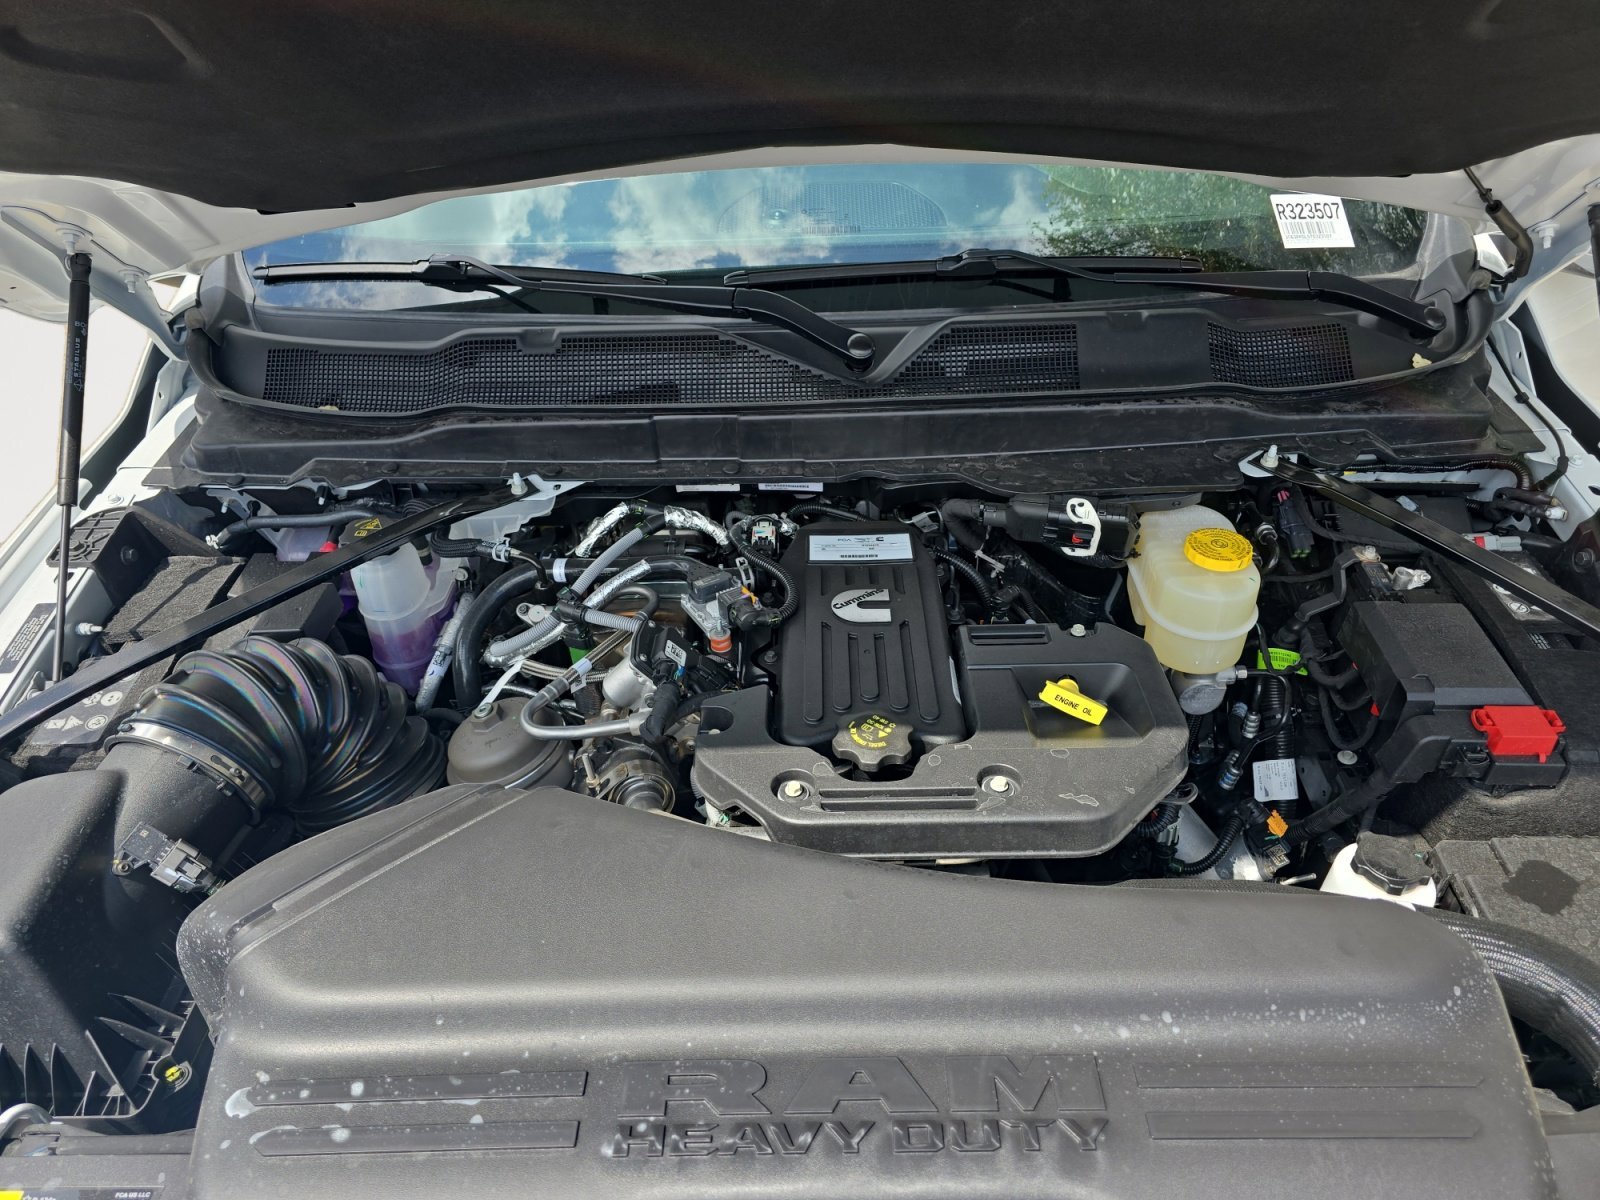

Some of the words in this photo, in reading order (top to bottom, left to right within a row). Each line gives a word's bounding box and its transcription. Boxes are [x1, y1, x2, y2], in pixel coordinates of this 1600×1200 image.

[1275, 203, 1340, 220] R323507
[832, 587, 885, 610] Cummins
[1054, 694, 1080, 710] ENGINE
[1082, 707, 1092, 716] OIL
[617, 1055, 1108, 1118] RAM
[611, 1119, 876, 1158] HEAVY
[892, 1118, 1110, 1153] DUTY
